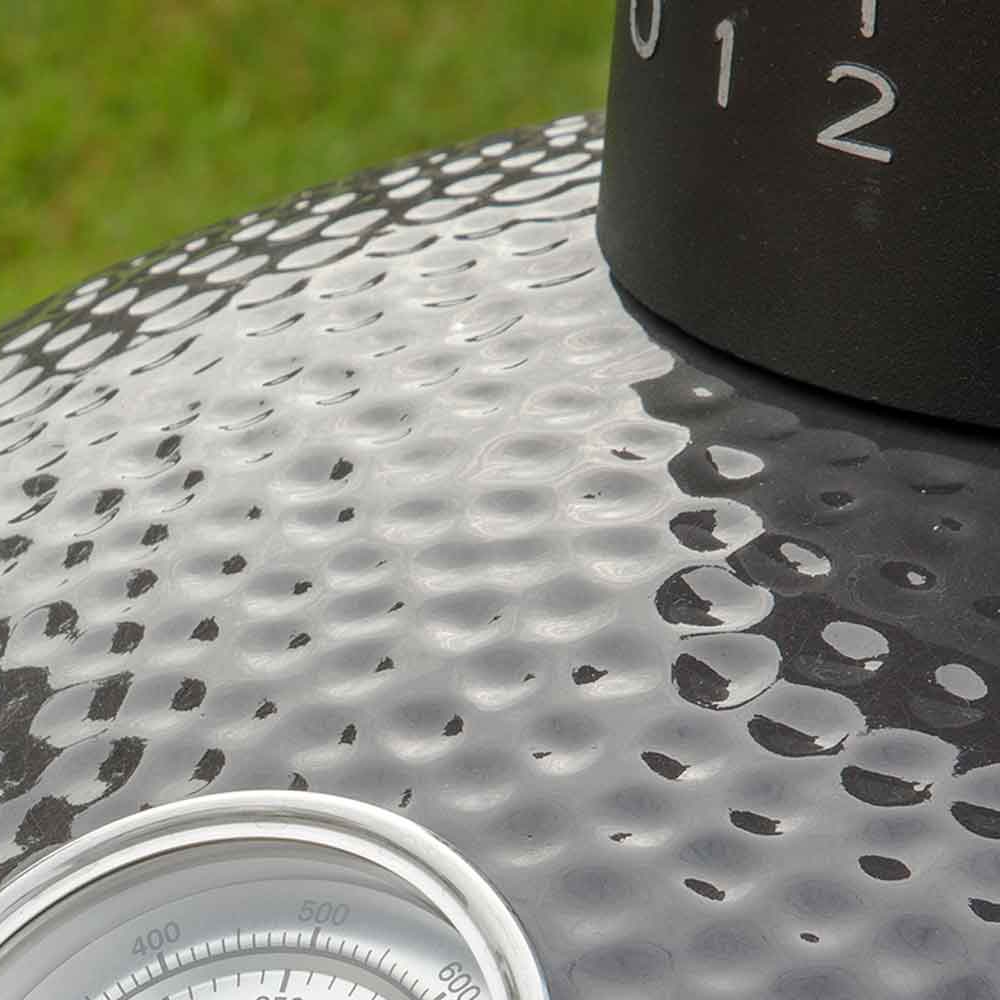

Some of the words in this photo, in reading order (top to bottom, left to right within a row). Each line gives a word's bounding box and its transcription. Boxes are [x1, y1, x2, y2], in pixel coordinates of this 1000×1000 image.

[715, 18, 735, 109] 1
[816, 62, 896, 163] 2
[298, 900, 350, 927] 500
[131, 921, 181, 958] 400
